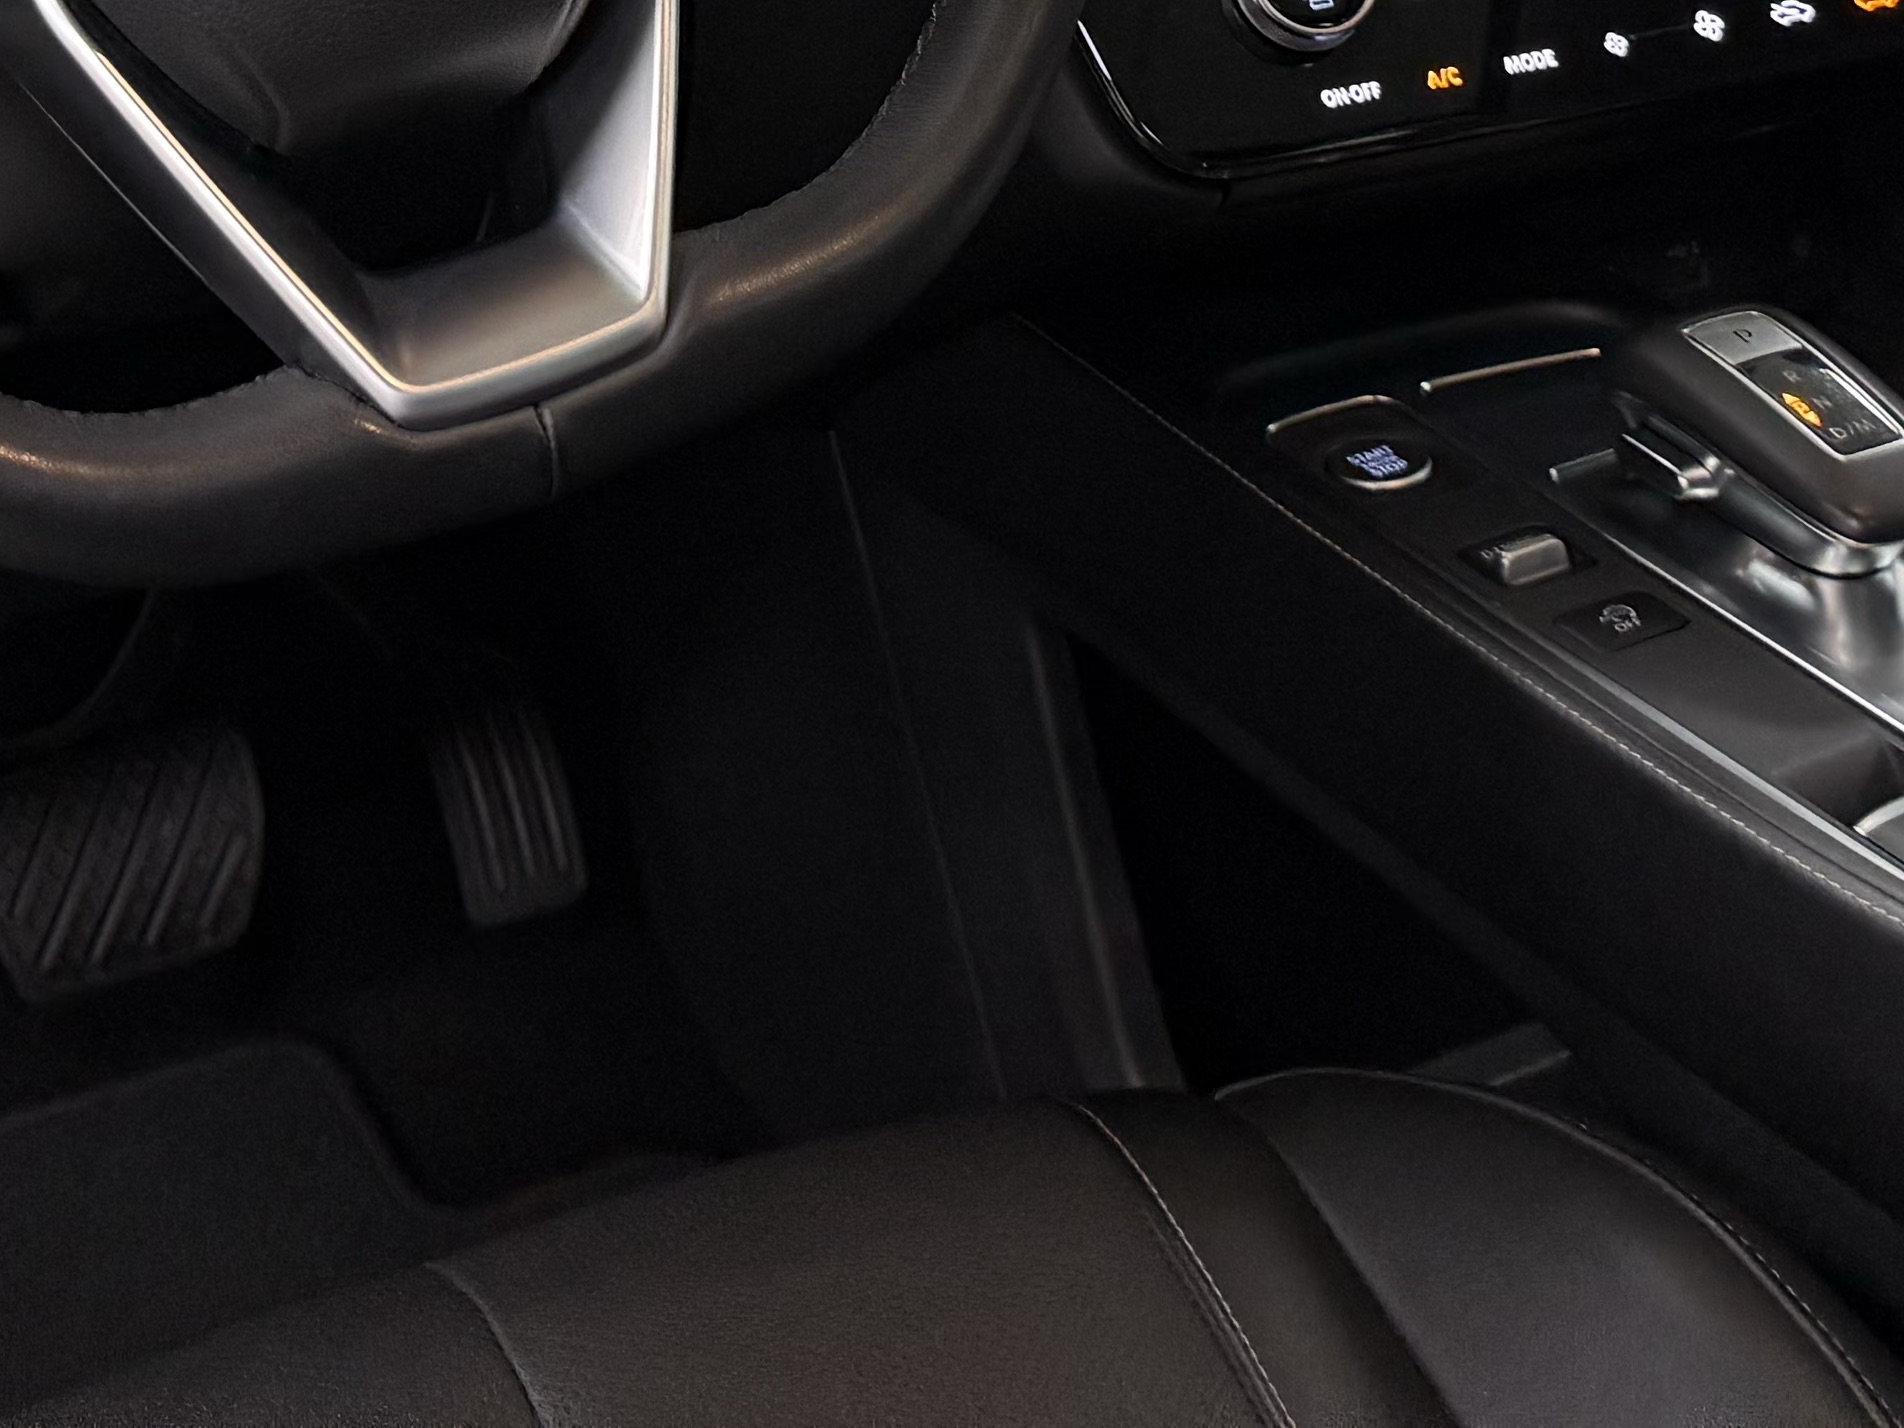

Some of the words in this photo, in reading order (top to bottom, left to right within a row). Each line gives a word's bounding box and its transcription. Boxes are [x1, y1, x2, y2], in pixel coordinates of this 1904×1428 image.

[1503, 48, 1559, 75] MODE
[1427, 66, 1463, 89] A/C
[1829, 418, 1879, 440] D/M
